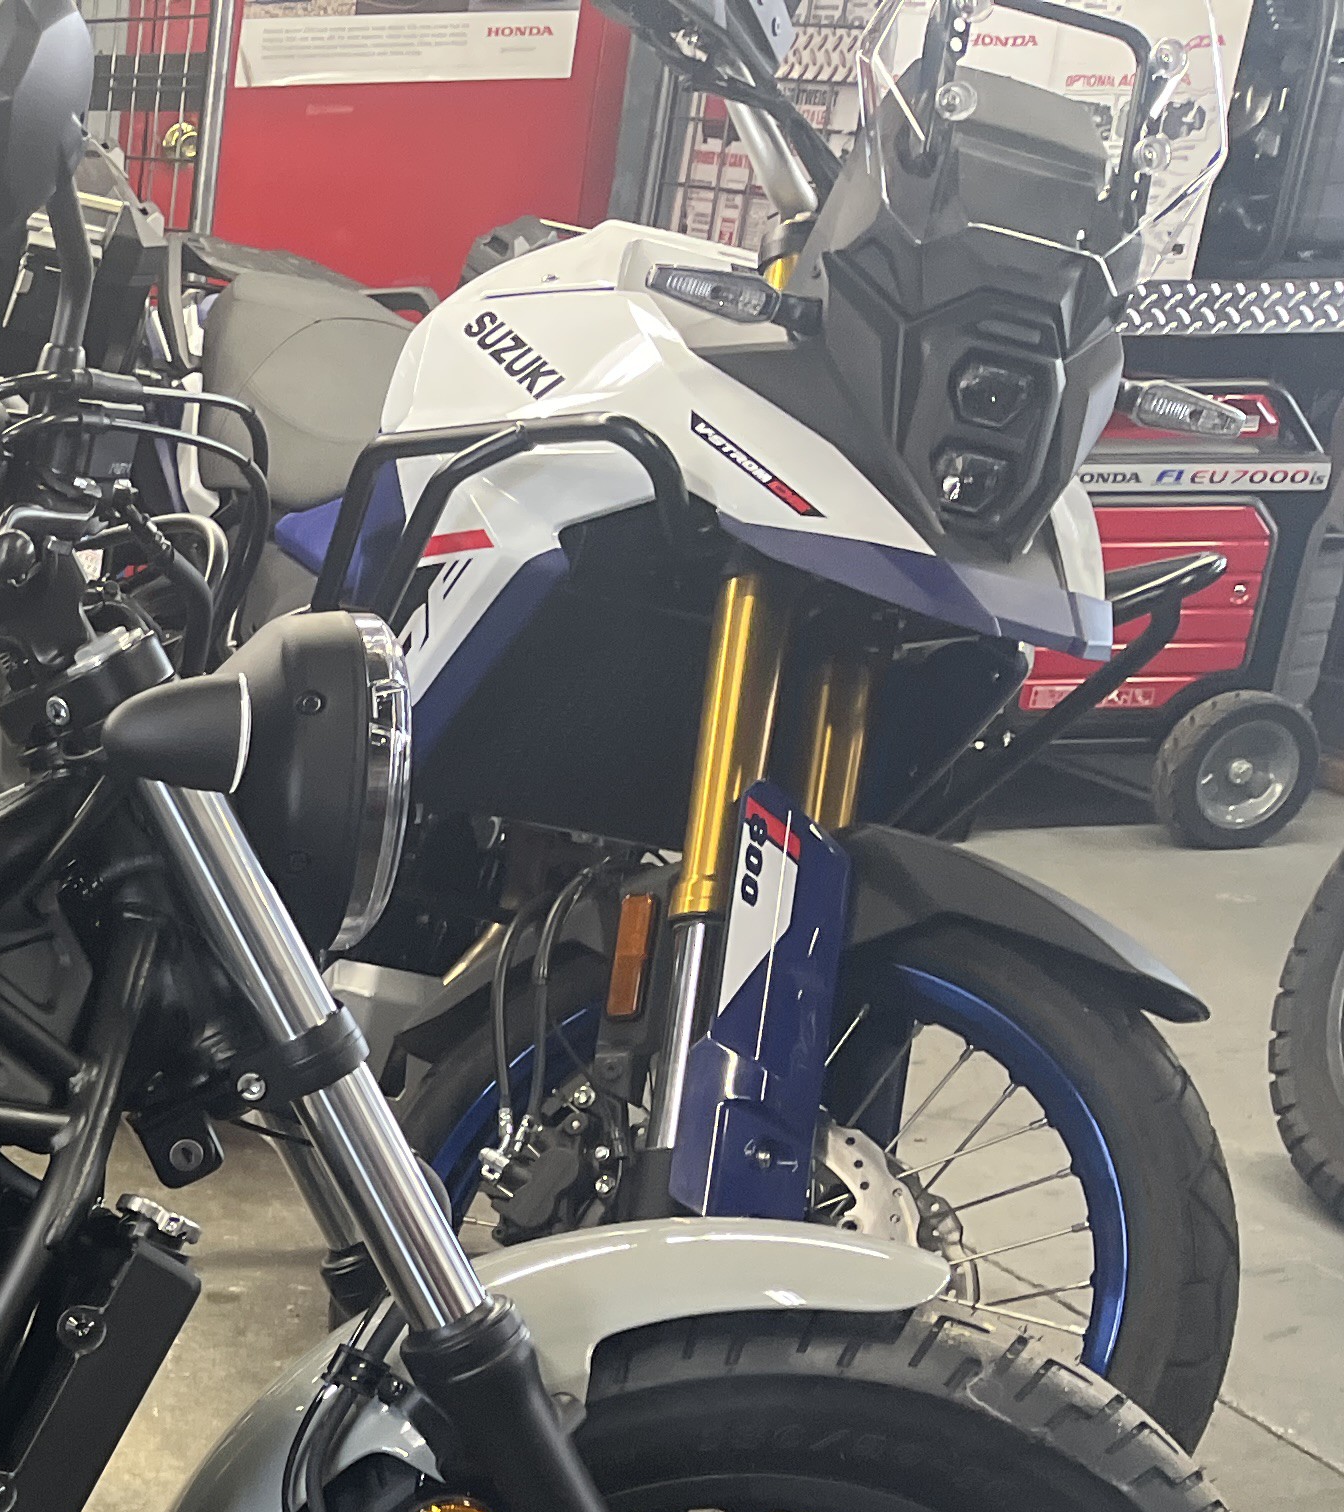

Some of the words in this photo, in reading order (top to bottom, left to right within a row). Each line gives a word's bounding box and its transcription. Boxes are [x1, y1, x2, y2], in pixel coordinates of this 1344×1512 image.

[486, 25, 555, 37] HONDA
[463, 311, 566, 401] SUZUKI
[1074, 471, 1142, 485] ONDA
[741, 813, 768, 908] 800
